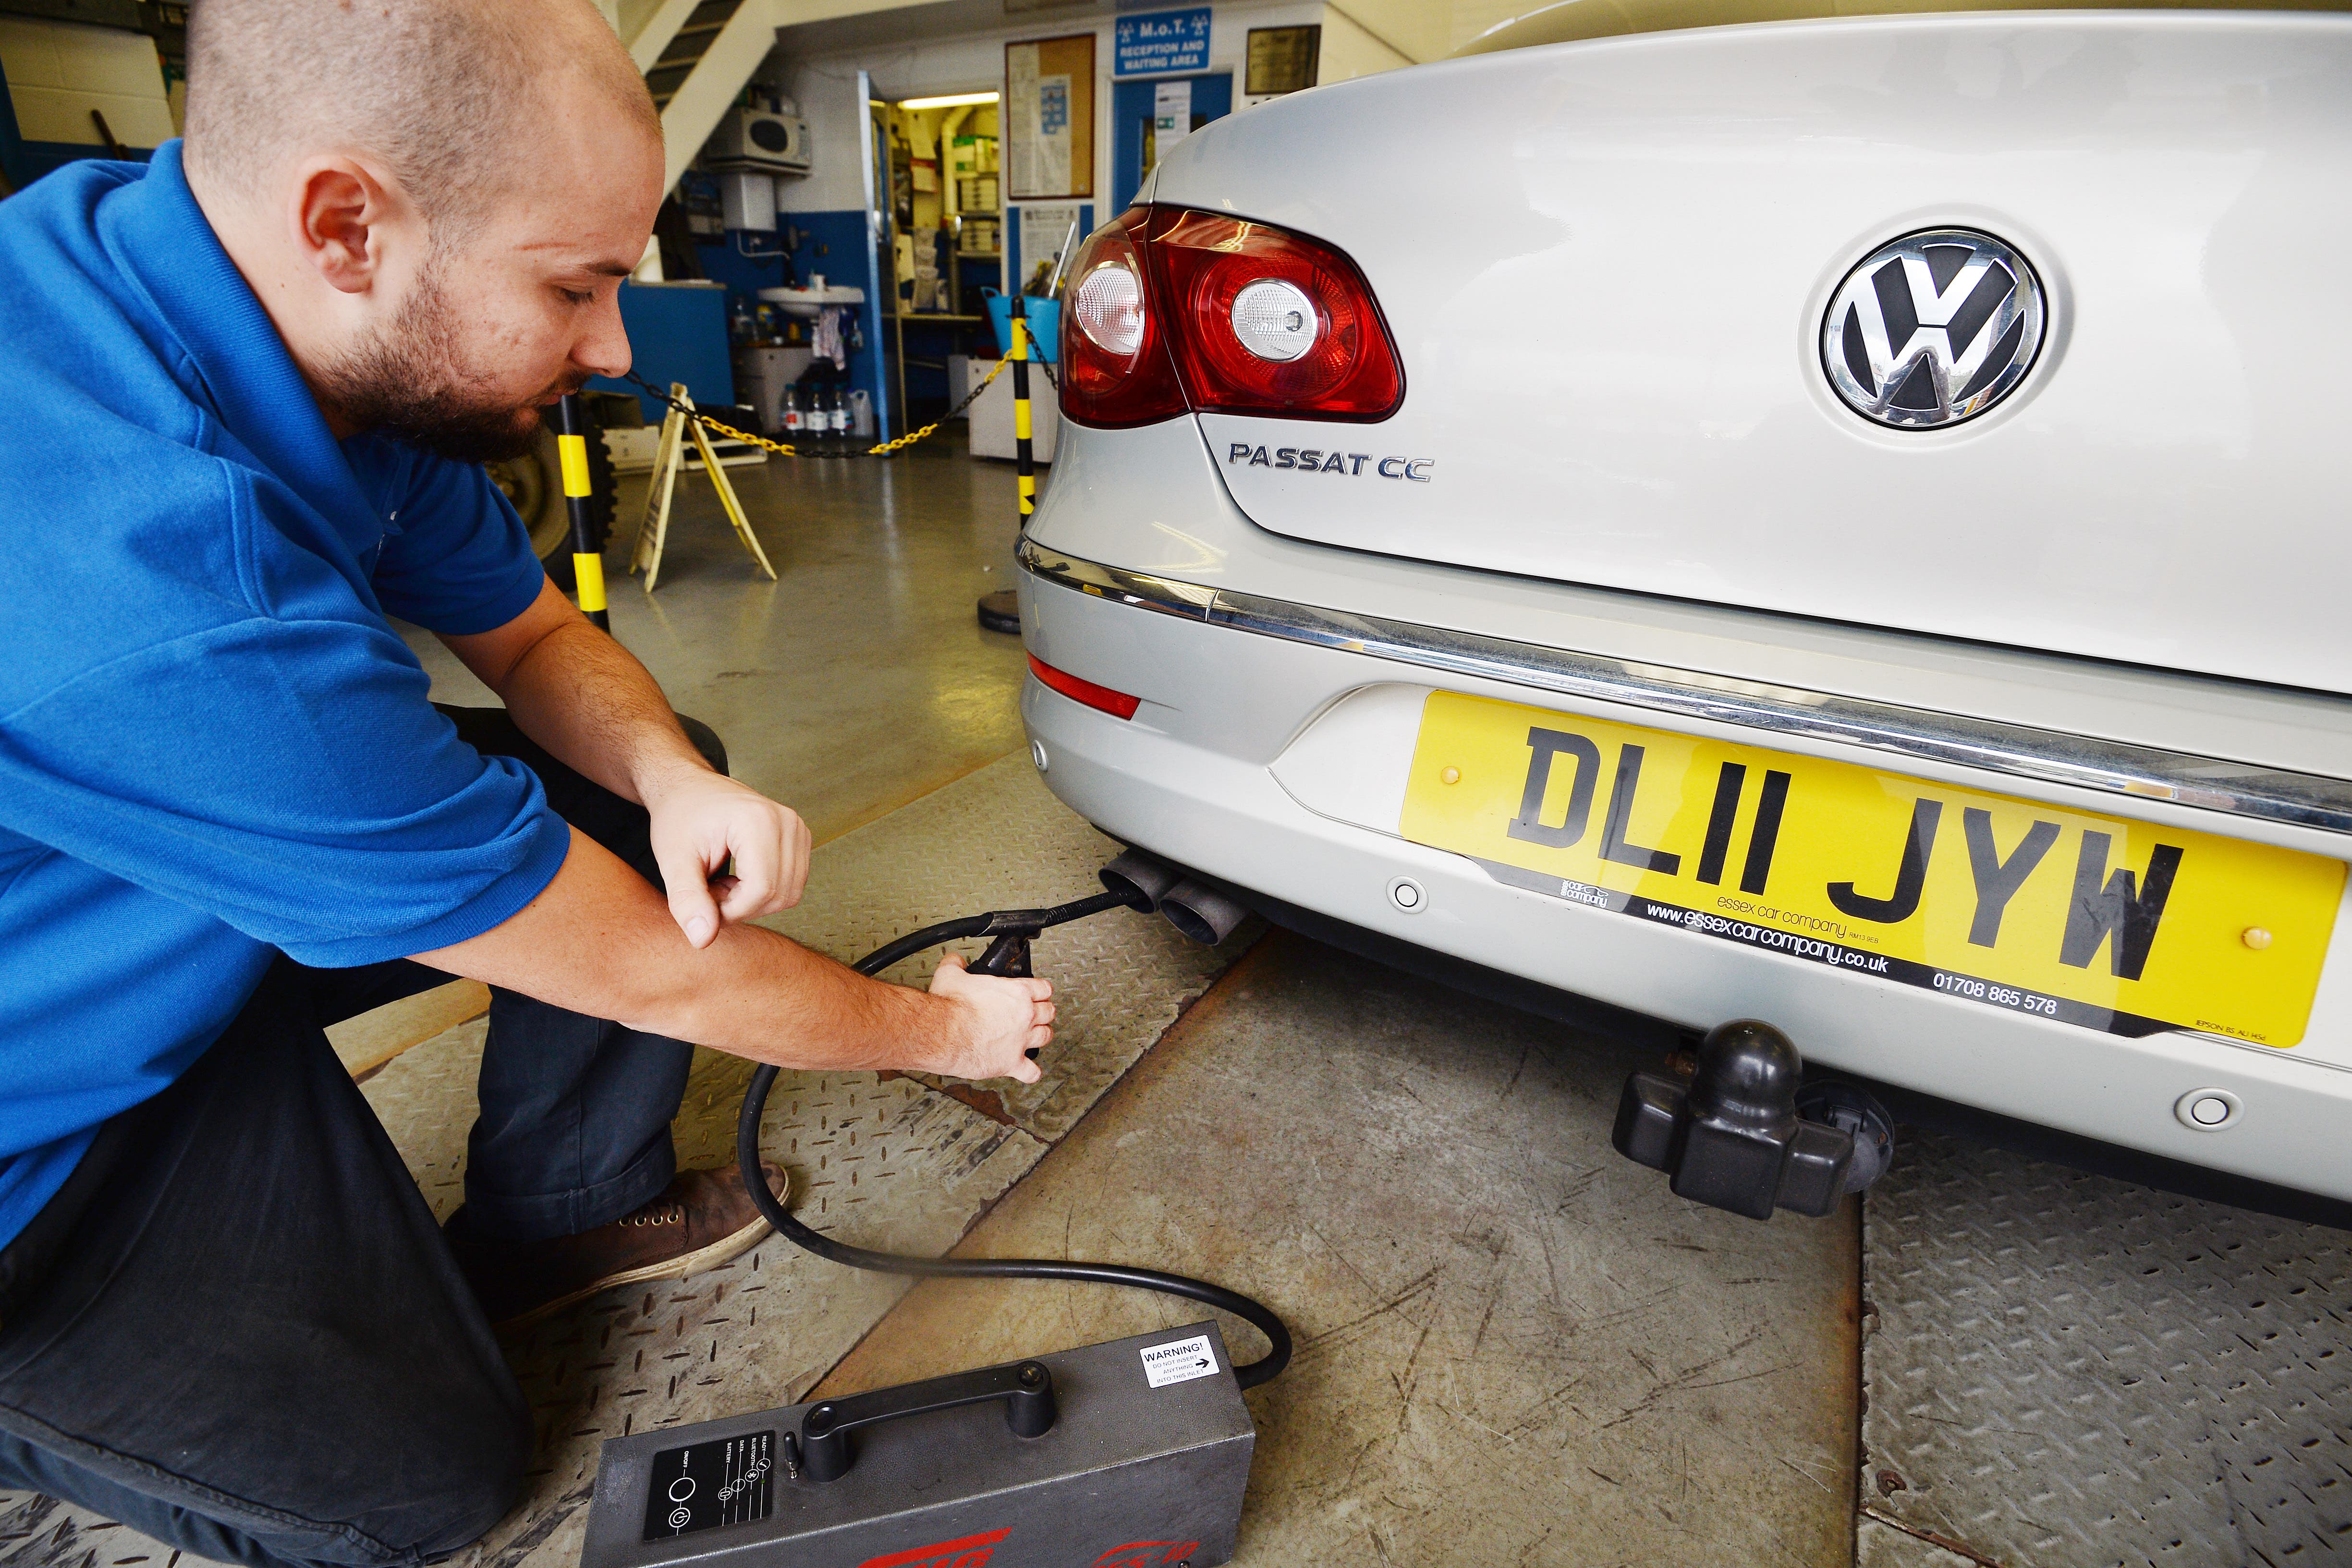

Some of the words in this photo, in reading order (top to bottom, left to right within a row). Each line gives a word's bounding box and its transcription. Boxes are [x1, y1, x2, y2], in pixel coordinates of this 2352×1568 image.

[1120, 43, 1179, 58] RECEPTION
[1182, 39, 1205, 52] AND
[1124, 56, 1168, 70] WAITING
[1170, 54, 1199, 66] AREA
[1229, 442, 1373, 476] PASSAT
[1377, 456, 1435, 482] CC
[1507, 726, 1791, 896] DL11
[1826, 797, 2184, 981] JYW
[1568, 881, 1585, 891] car
[1567, 889, 1608, 908] company
[1717, 896, 1755, 915] essex
[1757, 905, 1780, 920] car
[1782, 912, 1847, 938] company
[1849, 932, 1865, 940] RM13
[1647, 903, 1889, 973] www.essexcarcompany.co.uk
[1933, 973, 1986, 997] 01708
[1988, 986, 2021, 1006] 865
[2023, 994, 2057, 1015] 578
[1144, 1342, 1204, 1362] WARNING!
[1176, 1355, 1198, 1363] INSERT
[1163, 1363, 1194, 1374] ANYTHING
